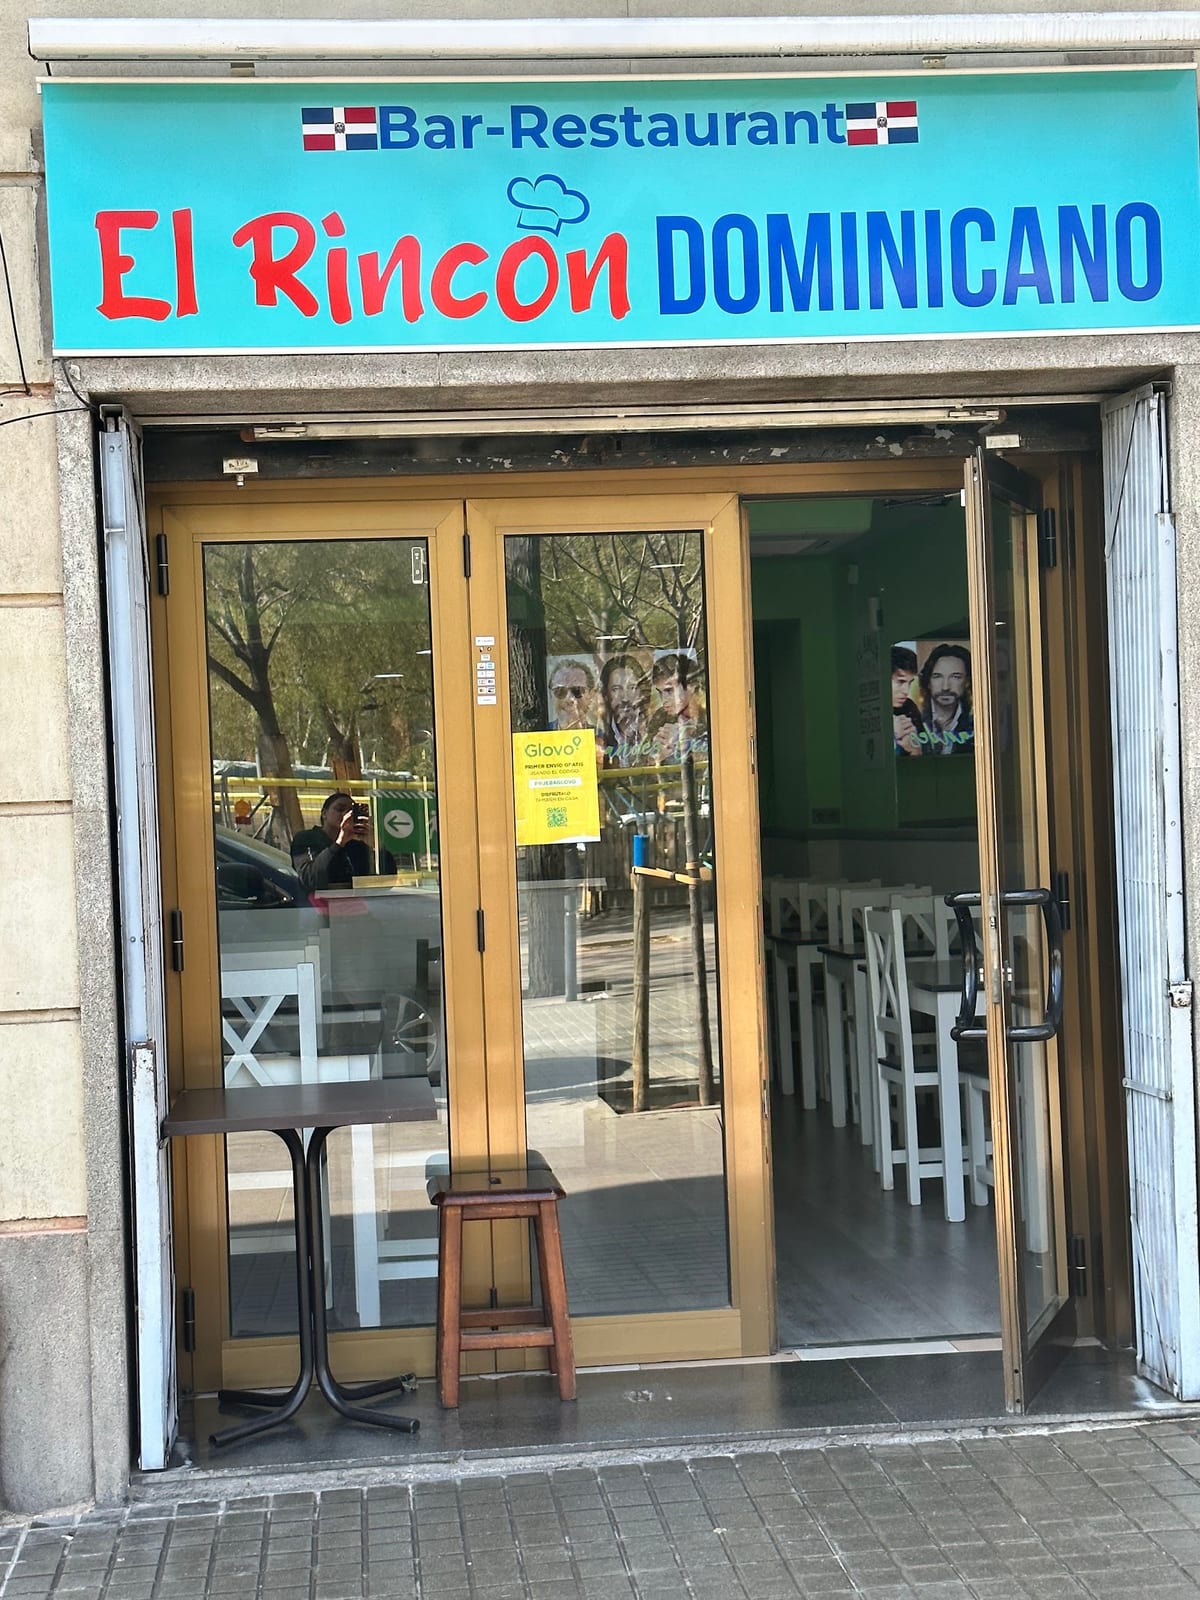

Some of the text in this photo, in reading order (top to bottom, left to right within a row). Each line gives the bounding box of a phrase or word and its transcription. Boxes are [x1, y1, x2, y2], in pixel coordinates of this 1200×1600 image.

[378, 103, 847, 150] Bar-Restaurant
[95, 208, 198, 322] El
[656, 202, 1163, 315] DOMINICANO
[525, 743, 574, 758] Glovo
